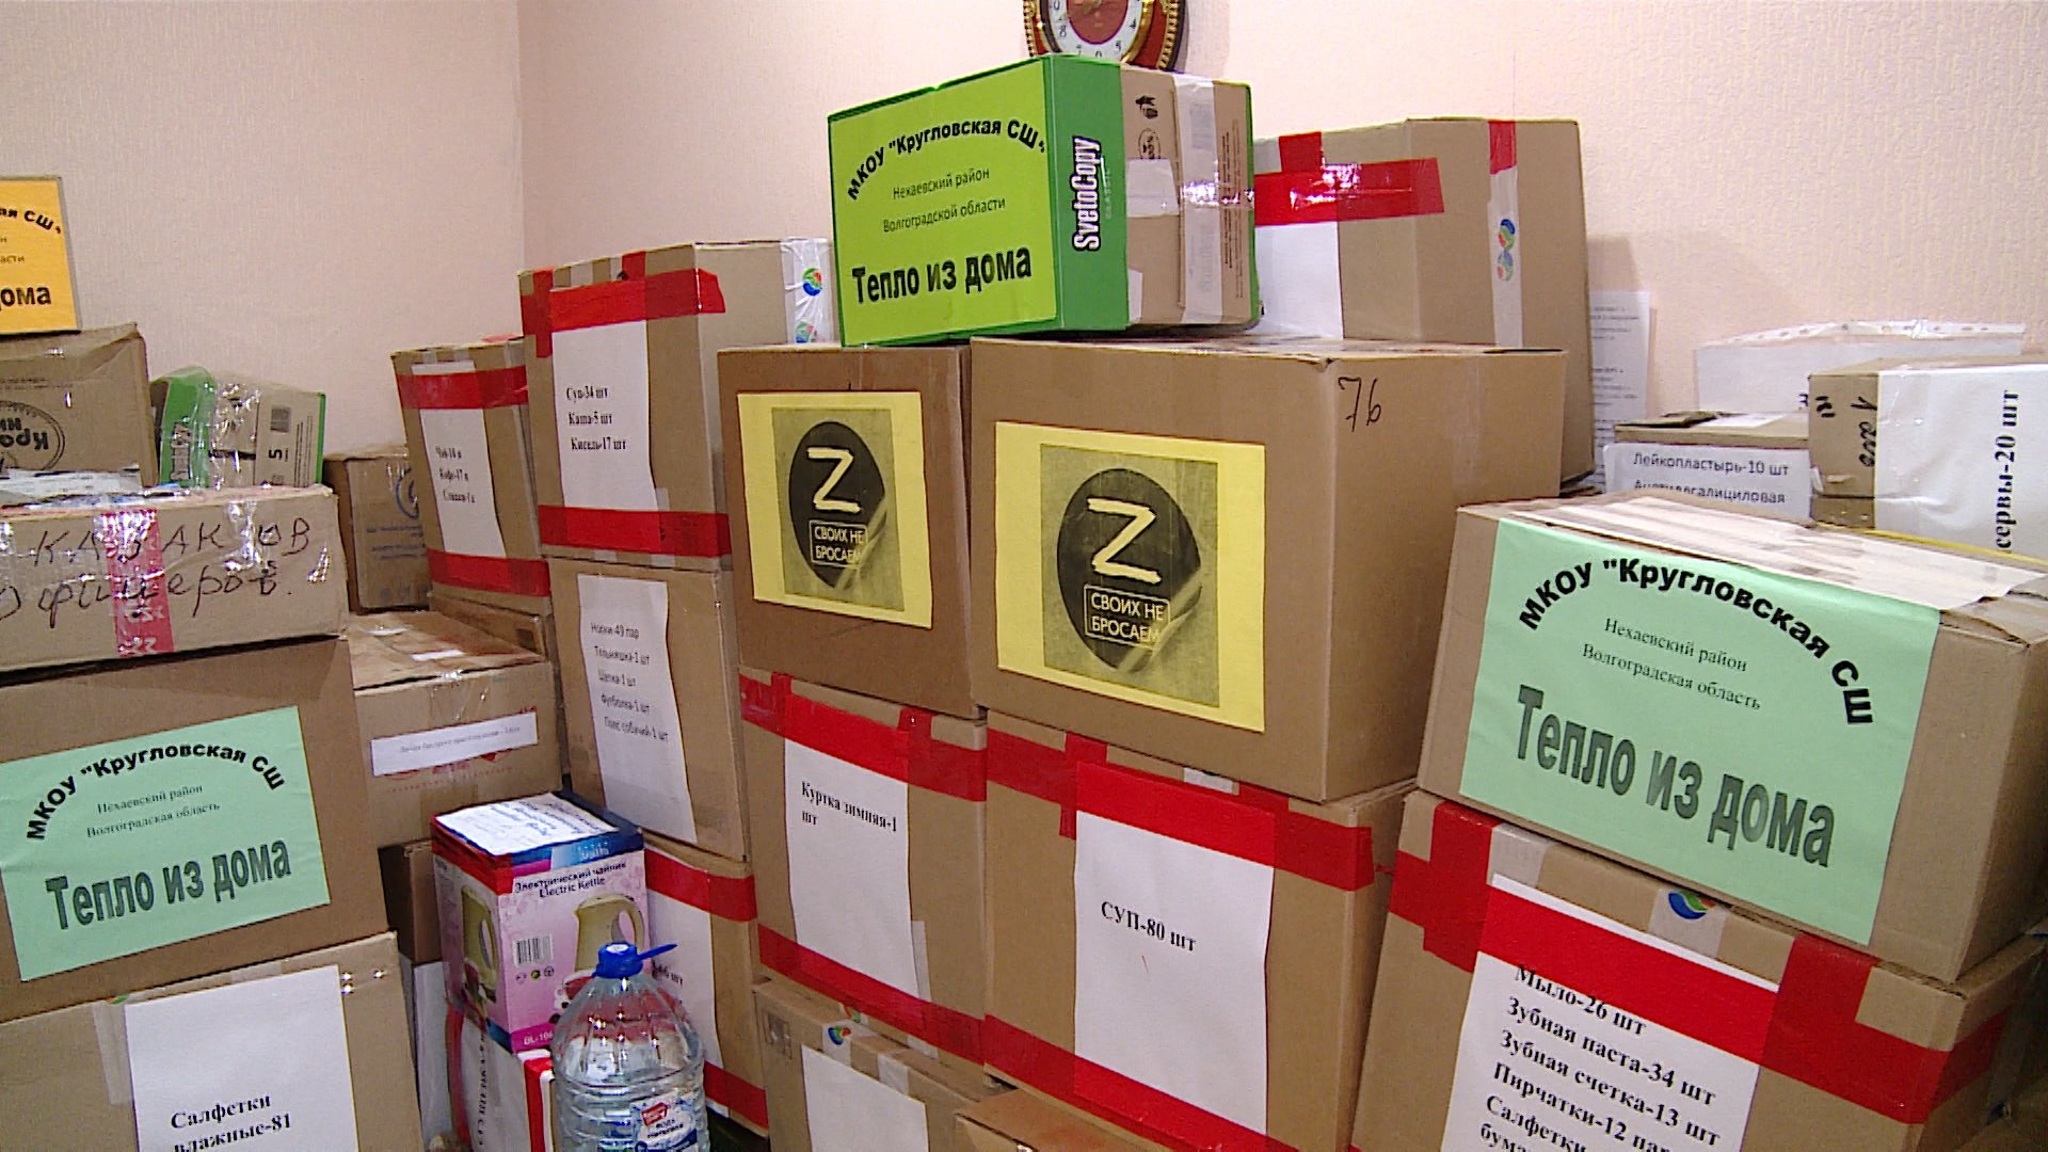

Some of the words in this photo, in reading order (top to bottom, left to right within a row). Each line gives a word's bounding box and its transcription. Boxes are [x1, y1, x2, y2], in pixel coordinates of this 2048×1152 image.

[848, 146, 884, 200] МКОУ
[888, 120, 1002, 155] "Кругловская
[1007, 119, 1045, 153] СШ"
[893, 172, 953, 200] Нехаевский
[955, 167, 990, 188] район
[882, 204, 958, 232] Волгоградской
[960, 198, 1006, 217] области
[1069, 137, 1102, 251] SvetoCopy
[0, 286, 52, 311] ома
[851, 267, 920, 304] Тепло
[926, 260, 957, 292] из
[965, 247, 1032, 294] дома
[1337, 376, 1382, 433] 76
[2001, 389, 2019, 427] шт
[807, 446, 861, 513] Z
[1769, 464, 1789, 476] шт
[814, 526, 849, 543] СВОИХ
[850, 529, 866, 545] НЕ
[1087, 497, 1162, 585] Z
[1090, 592, 1141, 618] СВОИХ
[1144, 603, 1165, 621] НЕ
[1518, 561, 1592, 631] МКОУ
[1602, 558, 1831, 660] "Кругловская
[1831, 659, 1874, 726] СШ
[1603, 617, 1695, 659] Нехаевский
[1697, 646, 1748, 673] район
[1581, 642, 1694, 690] Волгоградская
[1696, 681, 1761, 712] область
[26, 775, 77, 841] МКОУ
[80, 743, 247, 778] "Кругловская
[251, 755, 286, 791] СШ
[97, 789, 166, 815] Нехаевский
[168, 784, 203, 803] район
[802, 780, 840, 810] Куртка
[1517, 684, 1637, 798] Тепло
[1645, 749, 1703, 820] из
[1706, 773, 1836, 868] дома
[802, 810, 817, 826] шт
[44, 875, 155, 930] Тепло
[162, 860, 205, 904] из
[212, 839, 292, 902] дома
[1101, 901, 1165, 941] СУП-80
[1170, 931, 1197, 952] шт
[1515, 963, 1608, 1020] Мыло-26
[1612, 1010, 1648, 1036] шт
[1507, 995, 1577, 1044] Зубная
[1581, 1035, 1676, 1088] паста-34
[1681, 1079, 1717, 1106] шт
[171, 1095, 271, 1129] Салфетки
[1494, 1061, 1628, 1142] Пирчатки-12
[1500, 1028, 1569, 1078] Зубная
[1574, 1069, 1680, 1127] счетка-13
[1685, 1121, 1721, 1147] шт
[174, 1113, 291, 1152] влажные-81
[1486, 1095, 1587, 1152] Салфетки
